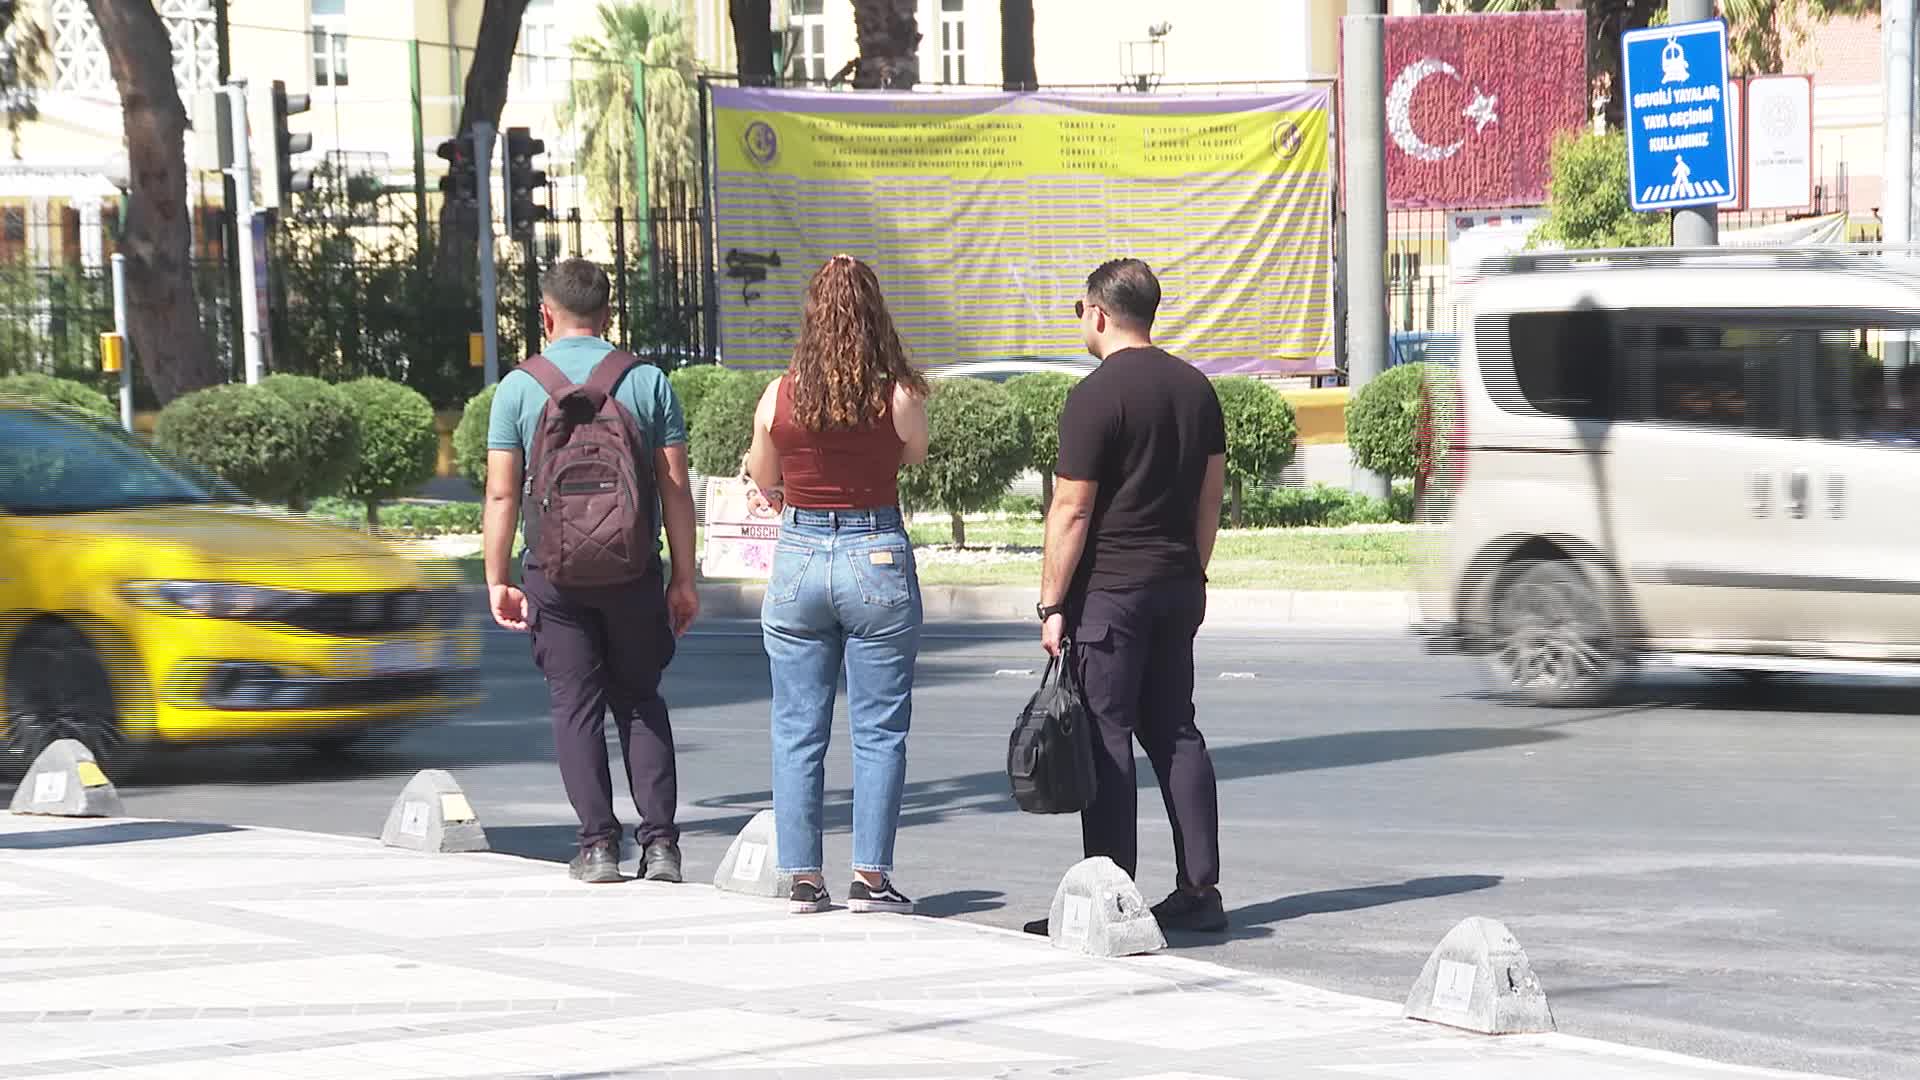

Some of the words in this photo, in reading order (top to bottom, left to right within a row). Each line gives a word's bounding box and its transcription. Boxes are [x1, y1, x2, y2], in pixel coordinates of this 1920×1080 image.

[1643, 112, 1669, 130] YAYA
[1669, 105, 1713, 129] GEÇİDİNİ
[1649, 131, 1710, 152] KULLANINIZ
[741, 527, 779, 537] MOSCHI
